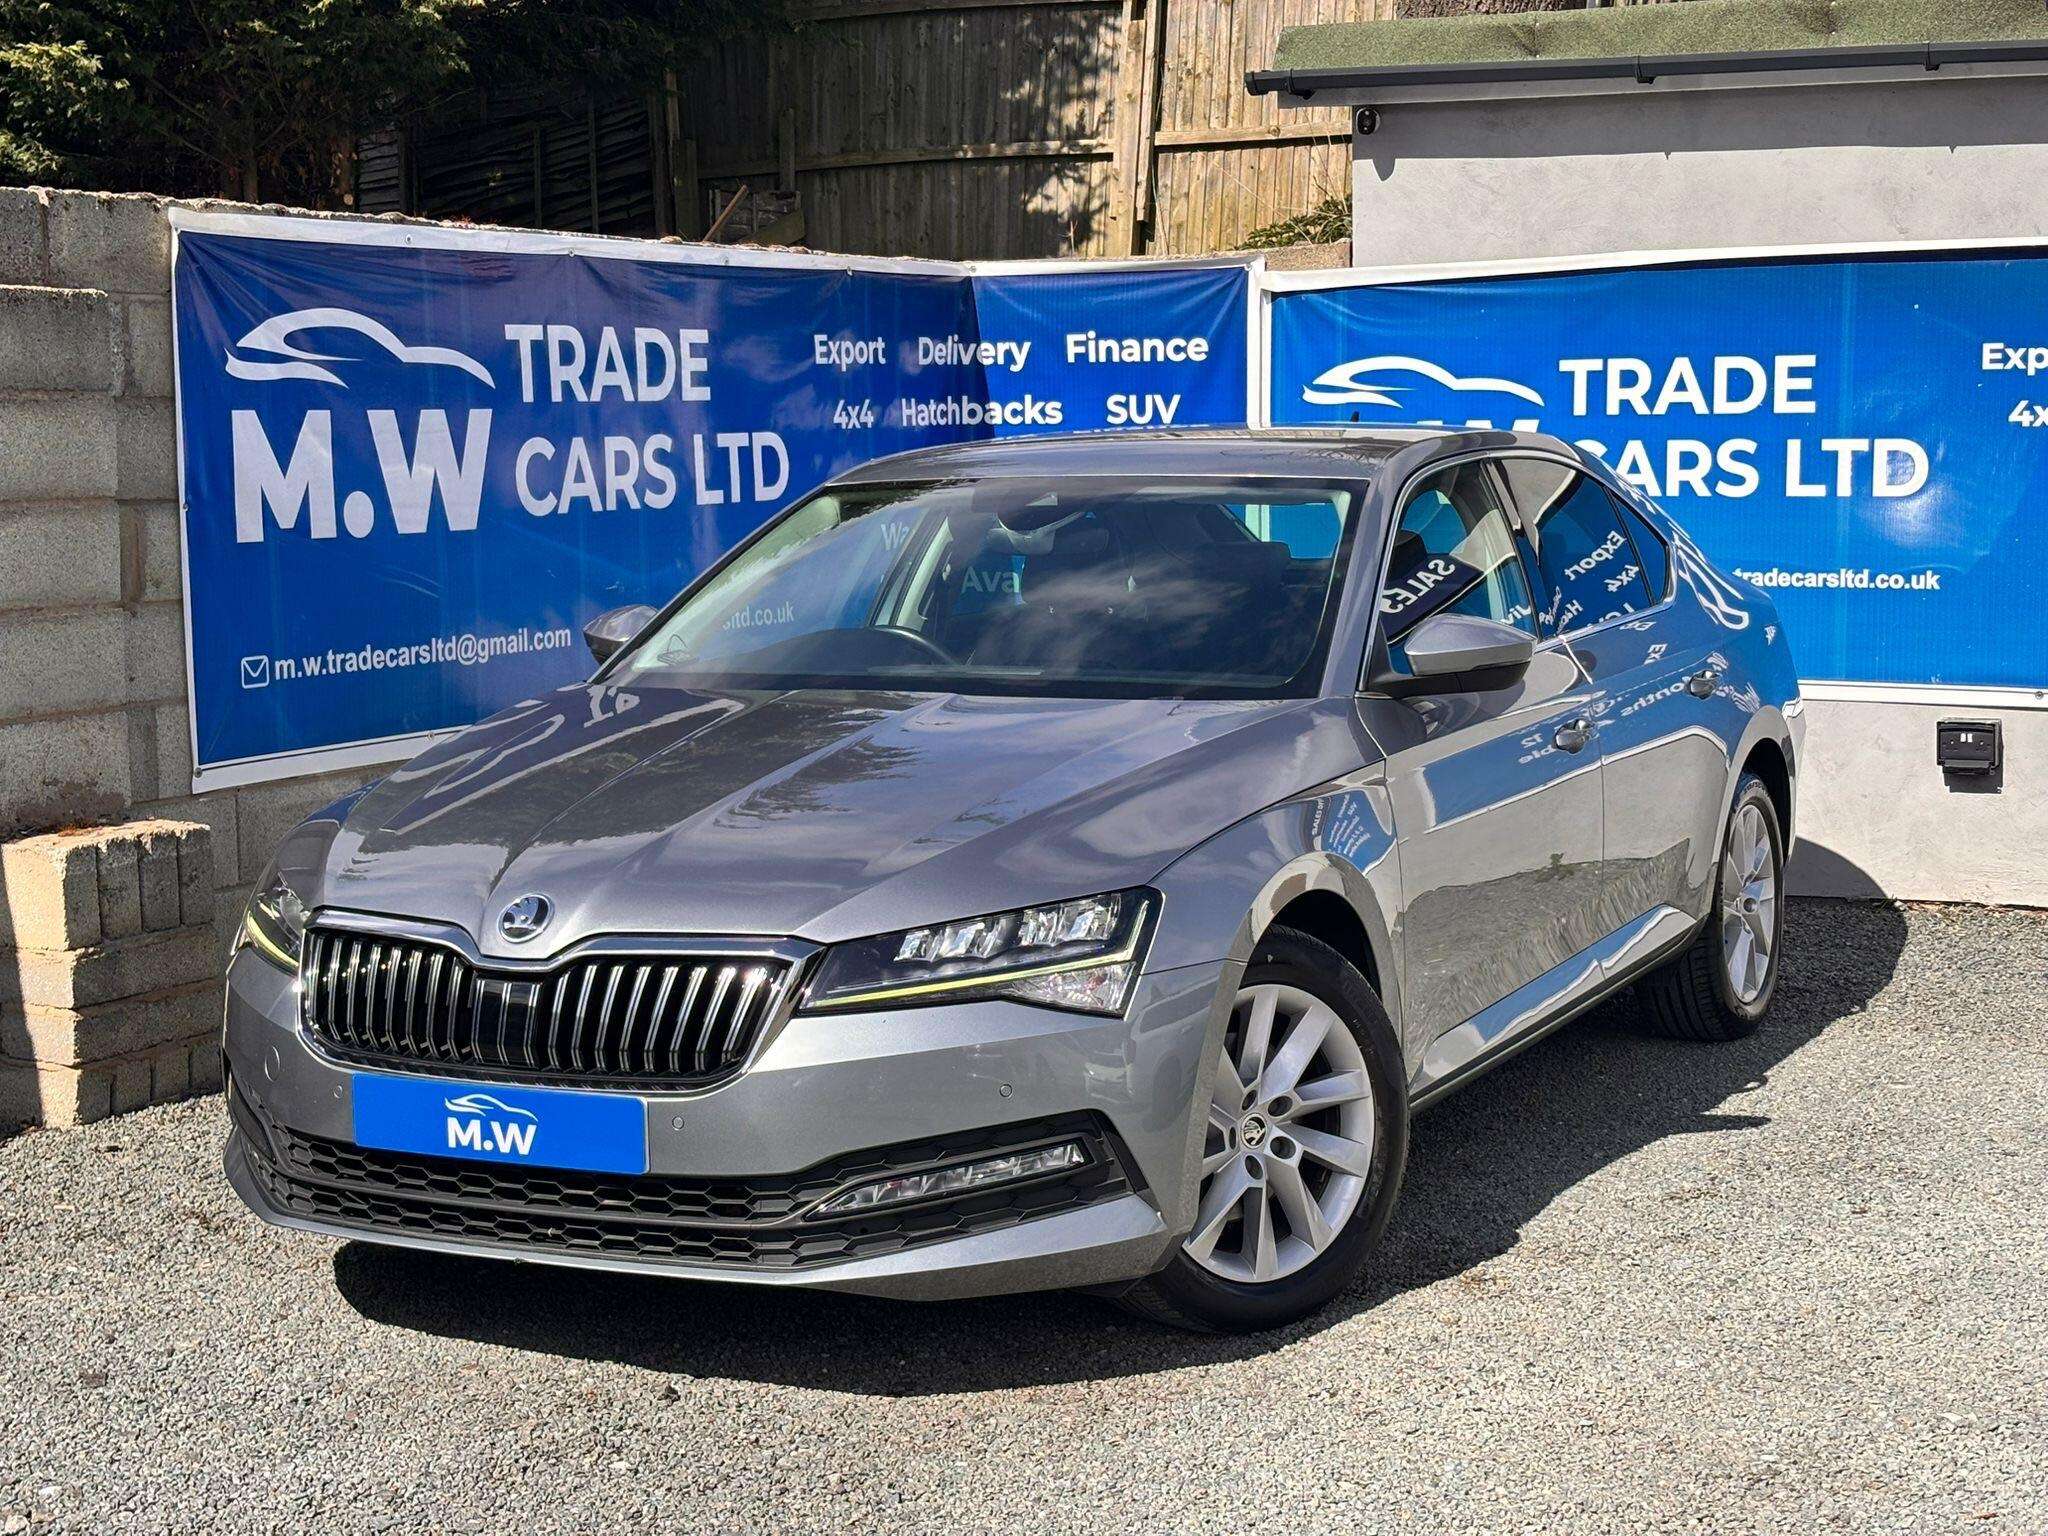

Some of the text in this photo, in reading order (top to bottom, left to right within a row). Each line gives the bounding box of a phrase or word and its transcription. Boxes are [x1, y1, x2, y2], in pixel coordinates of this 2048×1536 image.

[504, 322, 711, 403] TRADE
[813, 331, 1209, 372] Export Delivery Finance
[1981, 342, 2048, 376] Exp
[832, 394, 1181, 429] 4x4 Hatchbacks SUV
[1558, 354, 1817, 416] TRADE
[231, 408, 493, 543] M.W
[514, 430, 790, 517] CARS LTD
[1785, 438, 1930, 499] LTD
[274, 626, 572, 680] m.w.tradecarsltd@gmail.com
[446, 1115, 537, 1156] M.W
